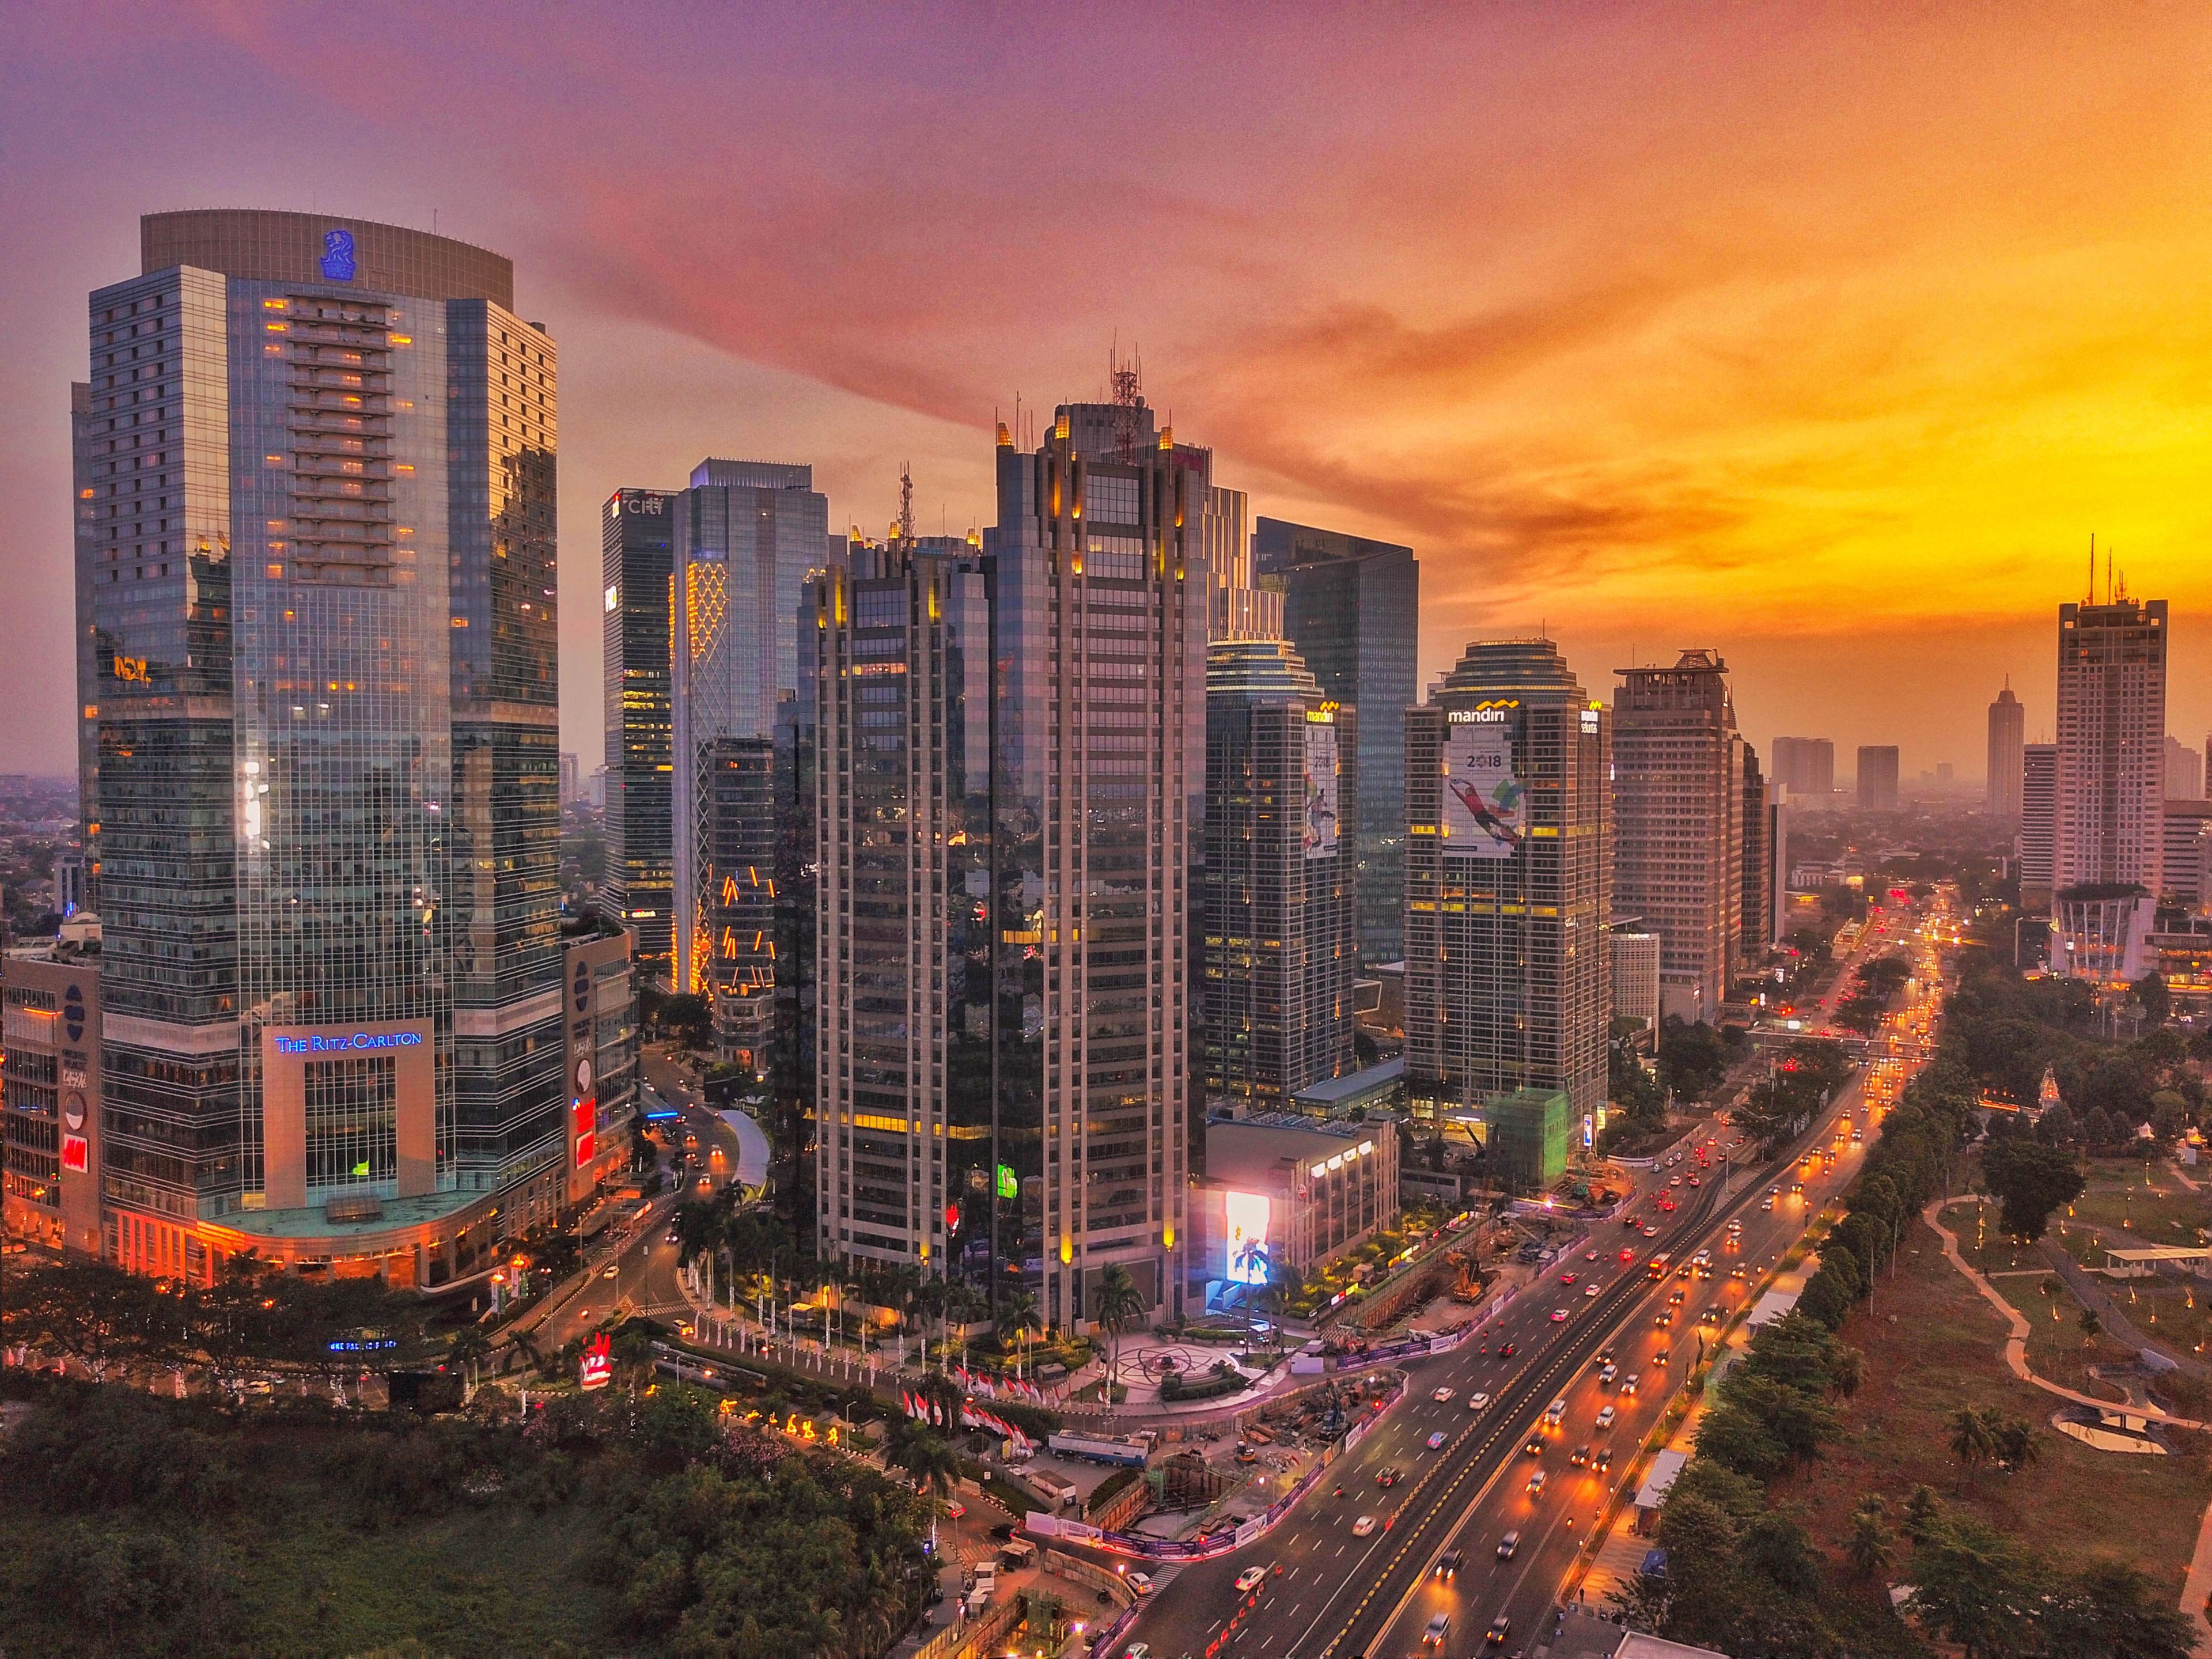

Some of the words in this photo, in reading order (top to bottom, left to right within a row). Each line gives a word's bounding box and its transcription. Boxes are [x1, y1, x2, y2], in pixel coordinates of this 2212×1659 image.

[628, 497, 664, 515] citi
[1448, 708, 1505, 722] mandiri
[275, 1037, 308, 1052] THE
[311, 1033, 422, 1051] RITZ-CARLTON
